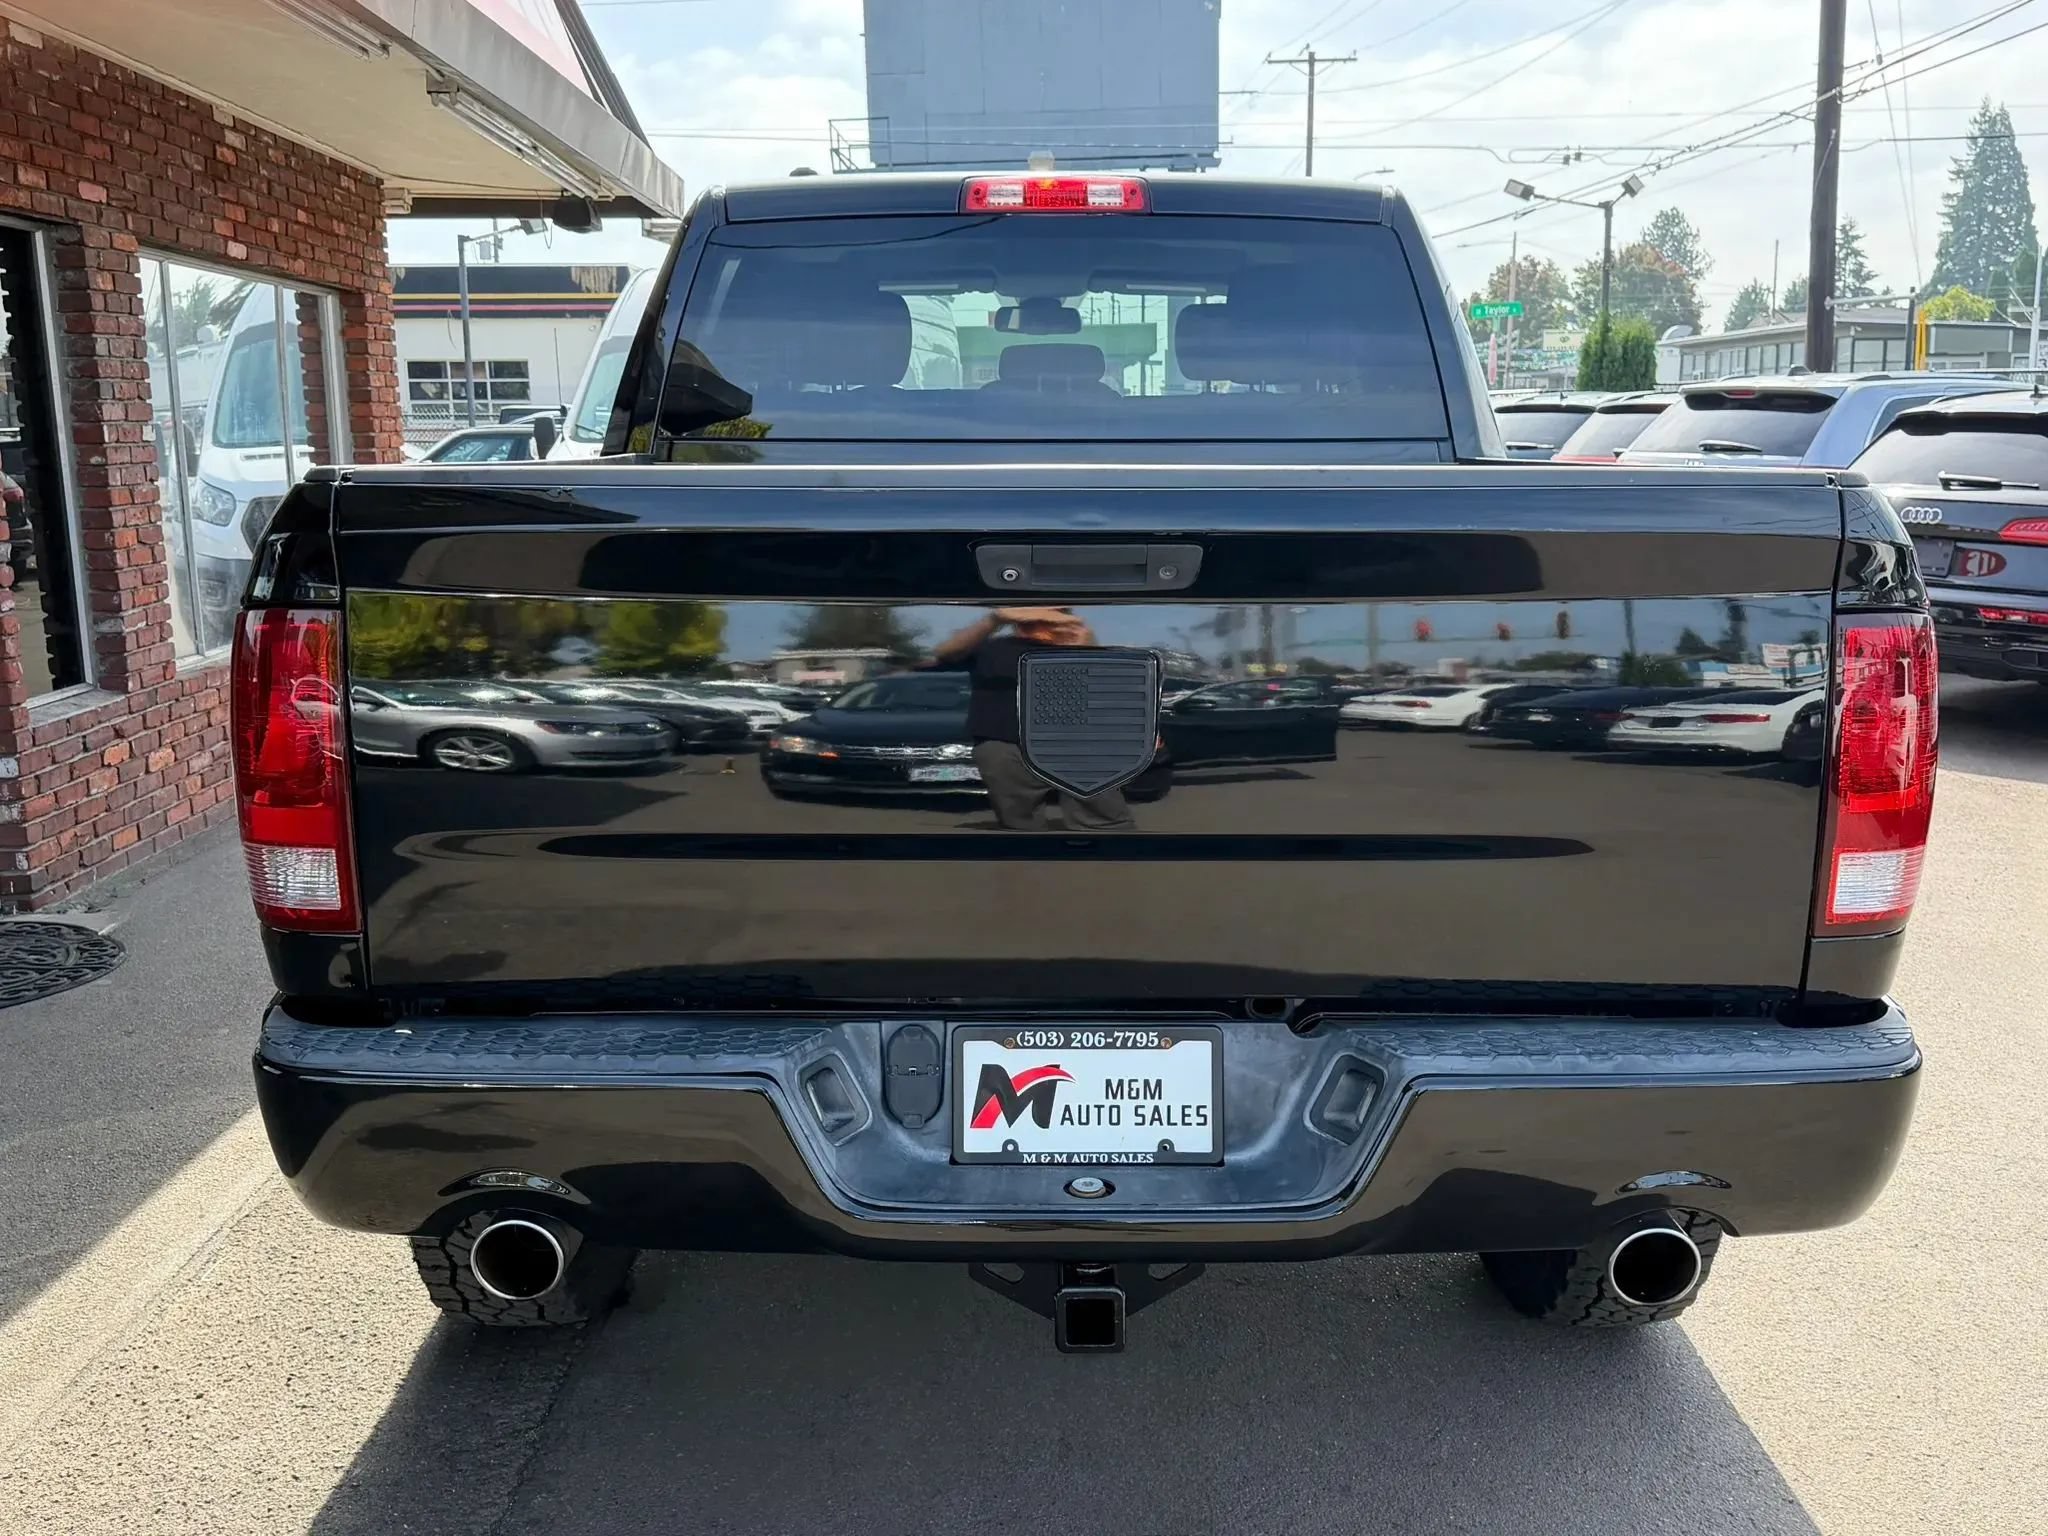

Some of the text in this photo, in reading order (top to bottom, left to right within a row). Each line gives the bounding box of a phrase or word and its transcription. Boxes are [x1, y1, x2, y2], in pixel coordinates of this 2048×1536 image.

[1484, 305, 1510, 317] Taylor
[1016, 1031, 1159, 1048] (503) 206-7795
[1105, 1078, 1163, 1100] M&M
[1060, 1104, 1208, 1126] AUTO SALES
[1023, 1153, 1154, 1163] M & M AUTO SALES
